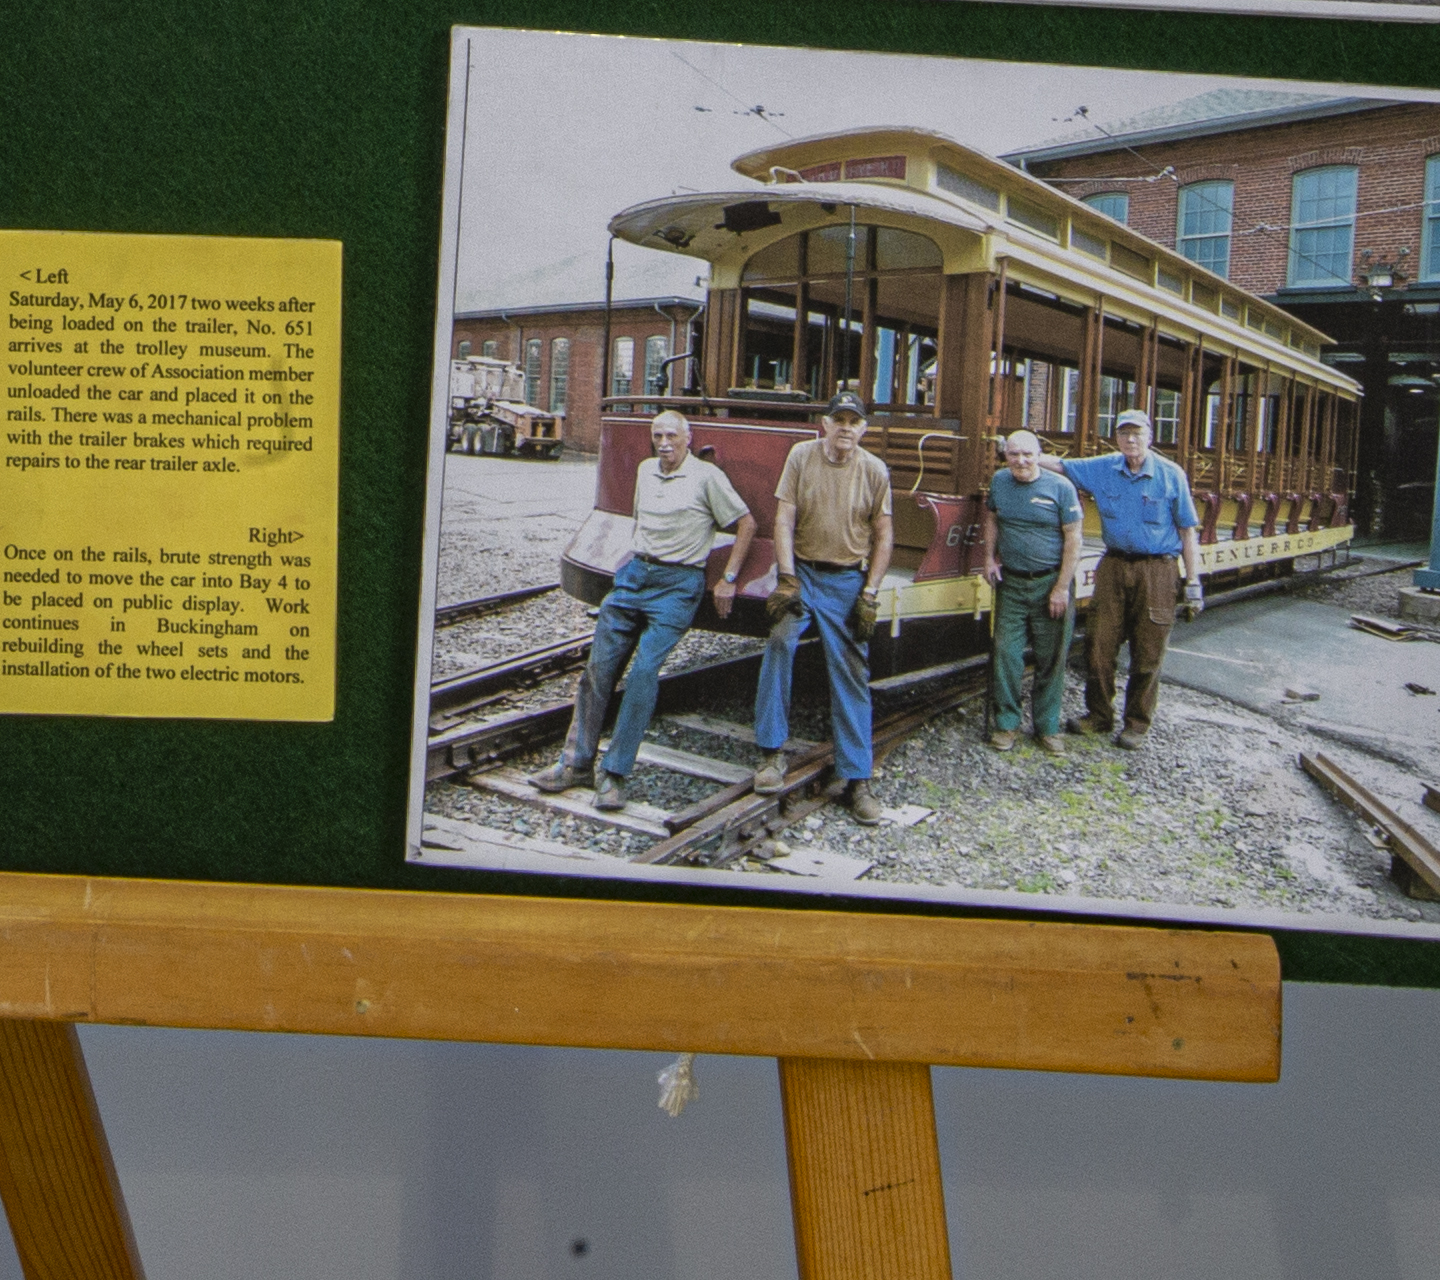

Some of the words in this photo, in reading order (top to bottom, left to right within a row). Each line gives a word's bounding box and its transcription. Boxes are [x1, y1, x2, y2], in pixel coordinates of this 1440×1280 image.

[8, 337, 62, 353] arrives
[74, 341, 88, 354] at
[100, 339, 124, 355] the
[136, 340, 187, 360] trolley
[199, 345, 270, 358] museum.
[283, 343, 314, 359] The
[7, 406, 45, 421] rails.
[52, 407, 97, 423] There
[102, 412, 133, 424] was
[138, 413, 147, 424] a
[152, 410, 242, 426] mechanical
[247, 412, 313, 431] problem
[3, 590, 22, 606] be
[32, 591, 83, 611] placed
[93, 597, 113, 608] on
[123, 594, 172, 613] public
[182, 595, 244, 616] display.
[265, 597, 310, 614] Work
[2, 615, 79, 631] continues
[110, 616, 126, 632] in
[157, 617, 258, 639] Buckingham
[289, 626, 310, 638] on
[2, 660, 90, 678] installation
[94, 662, 114, 678] of
[116, 663, 141, 679] the
[145, 666, 176, 680] two
[180, 665, 239, 682] electric
[244, 670, 304, 684] motors.
